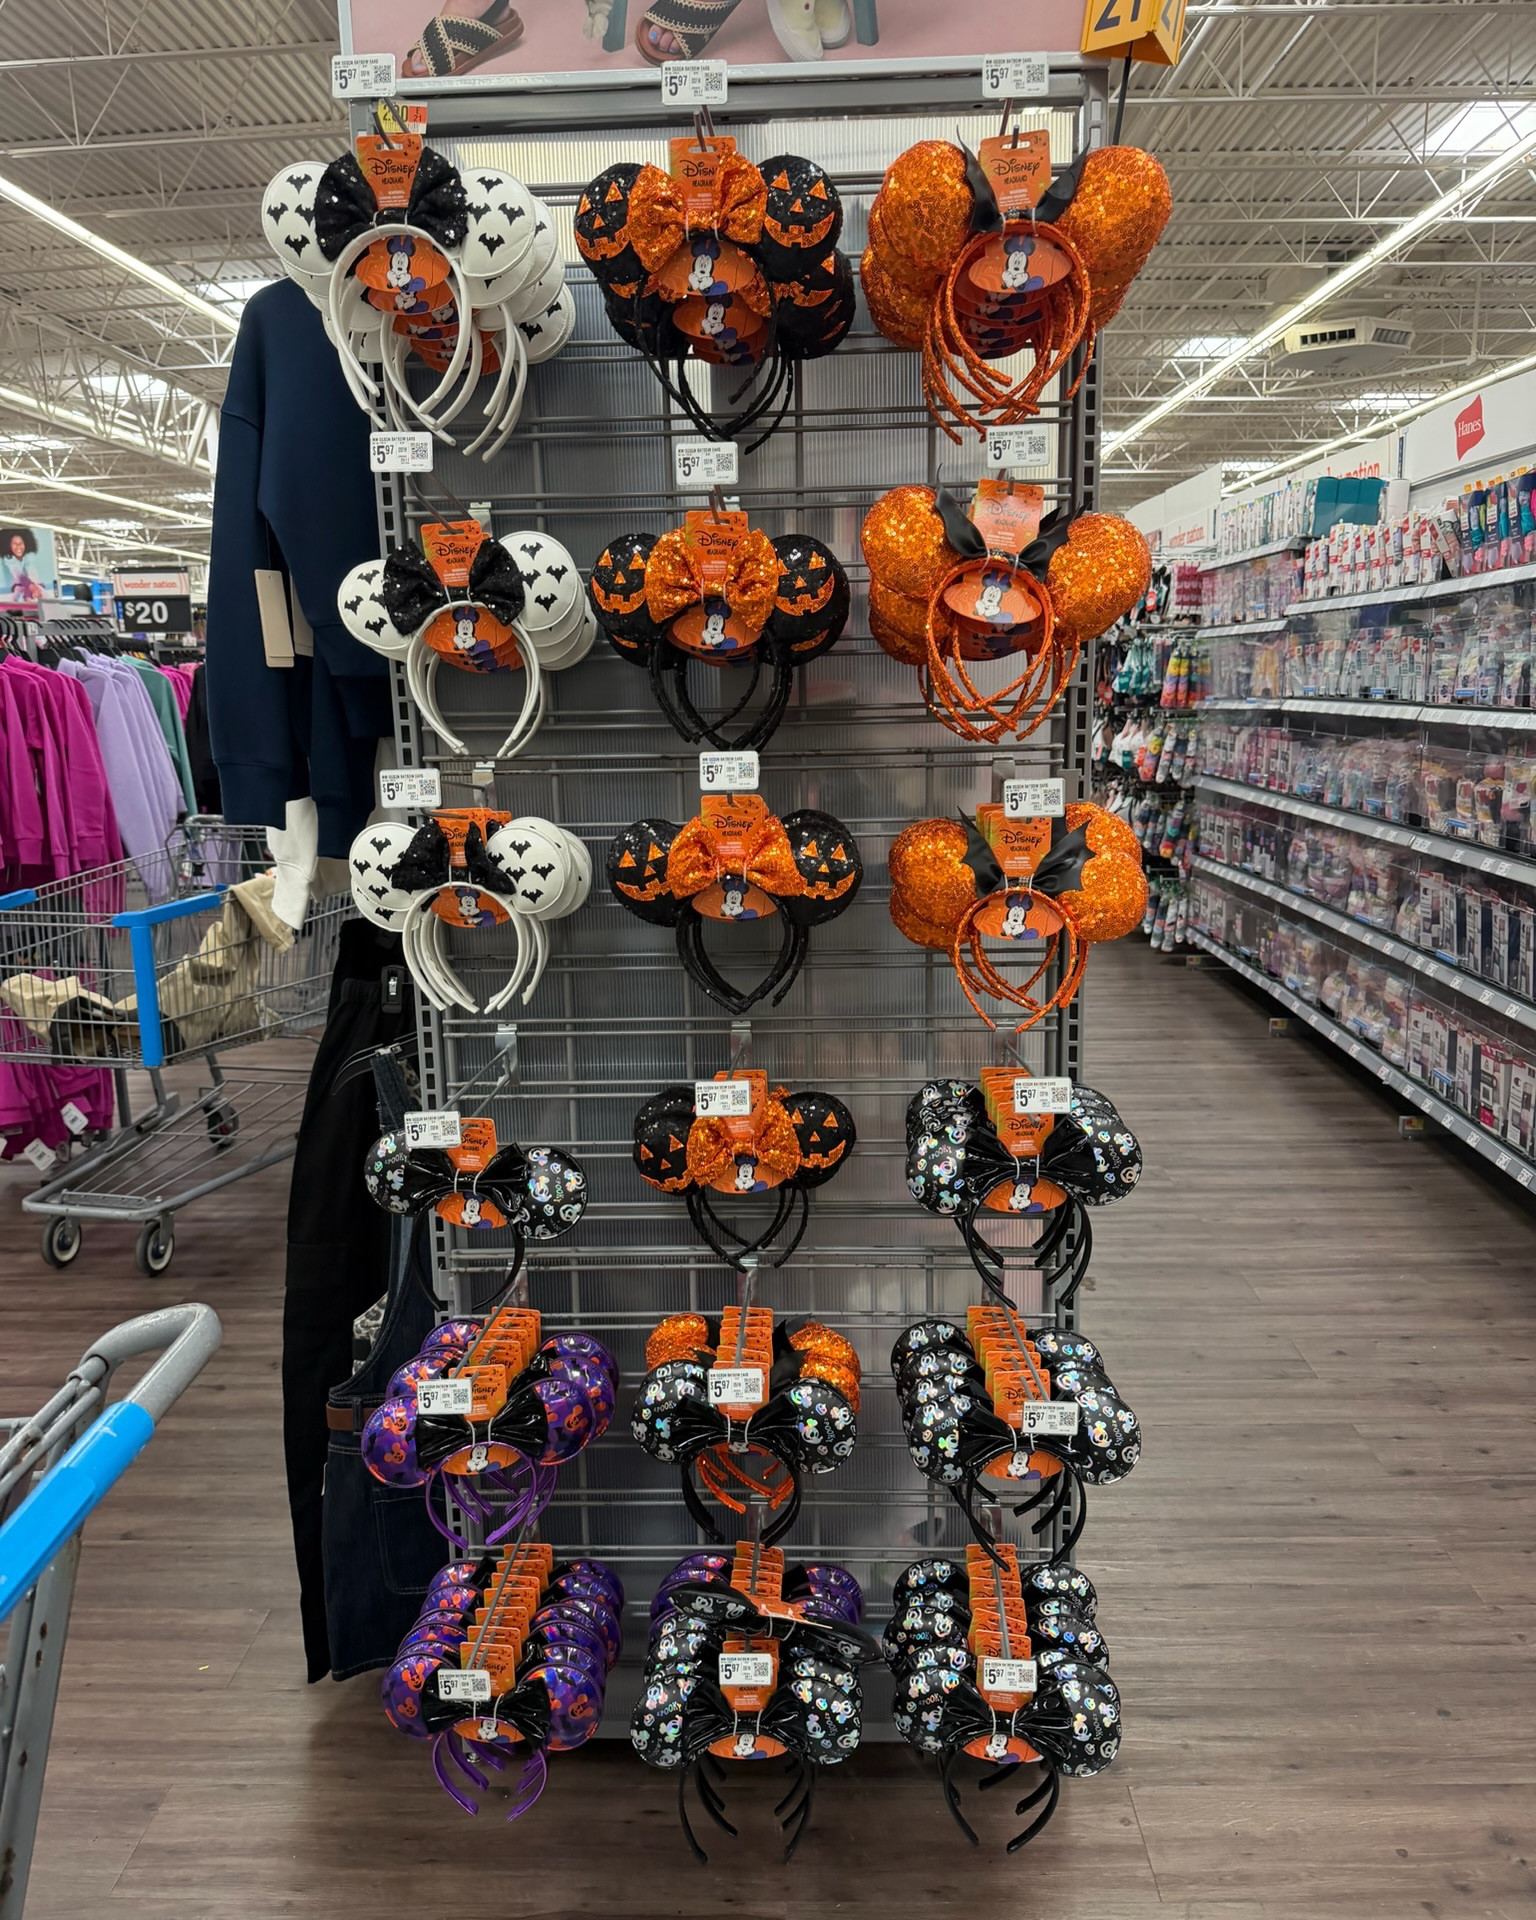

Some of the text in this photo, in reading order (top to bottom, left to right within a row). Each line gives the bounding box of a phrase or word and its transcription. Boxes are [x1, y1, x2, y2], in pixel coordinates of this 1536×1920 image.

[367, 157, 415, 178] Disney
[679, 159, 717, 178] Disn
[990, 158, 1040, 177] Disney
[1458, 419, 1482, 438] Hanes
[432, 541, 476, 558] Disney
[695, 530, 739, 550] Disney
[125, 601, 169, 624] $20
[710, 813, 753, 832] Disney
[1000, 829, 1042, 848] Disney
